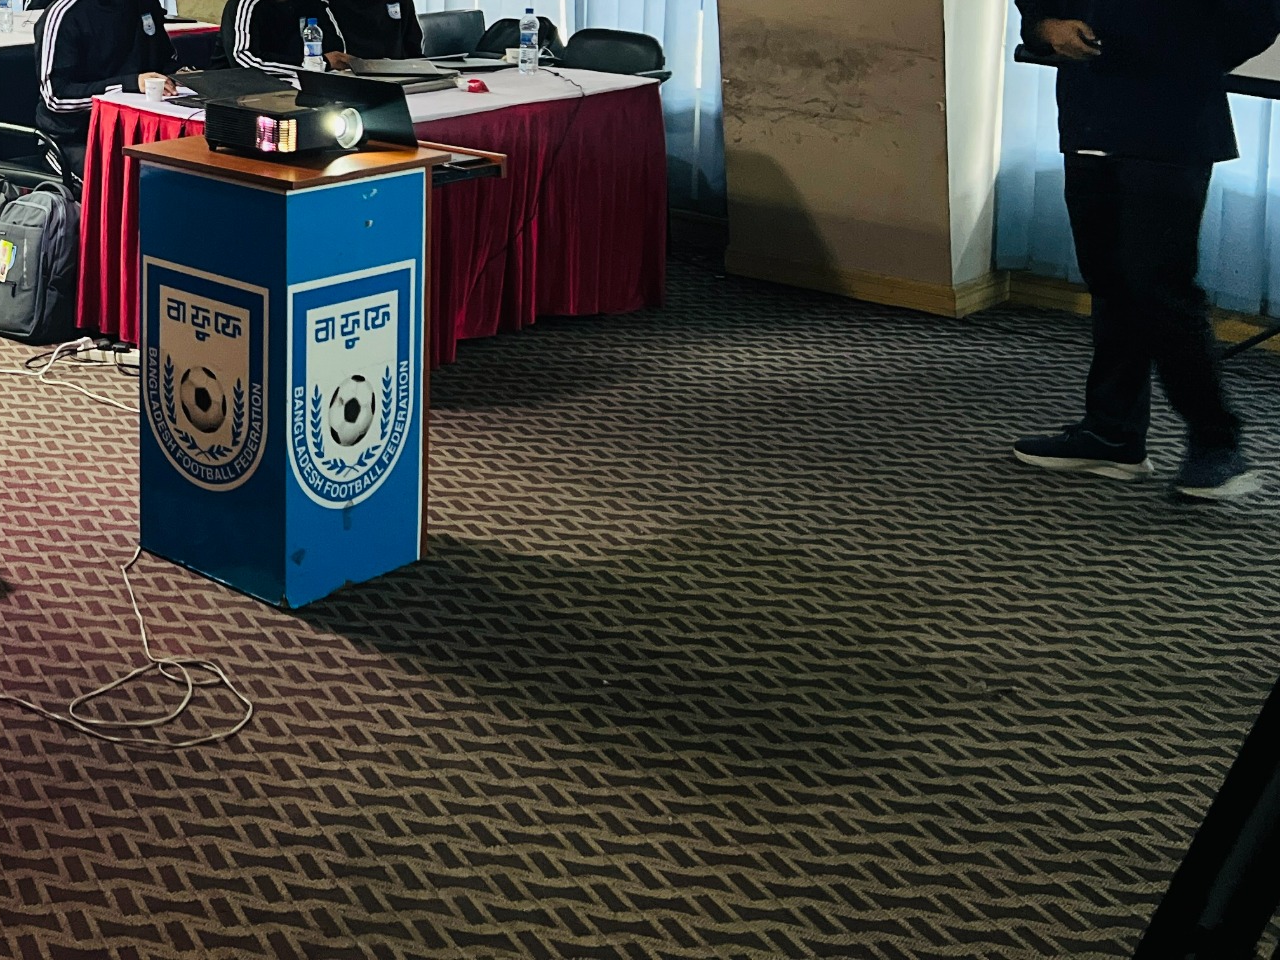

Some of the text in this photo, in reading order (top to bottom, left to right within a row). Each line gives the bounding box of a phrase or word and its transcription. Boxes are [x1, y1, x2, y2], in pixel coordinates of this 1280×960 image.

[147, 346, 263, 480] BANGLADESH FOOTBALL FEDERATION
[292, 359, 410, 499] BANGLADESH FOOTBALL FEDERATION
